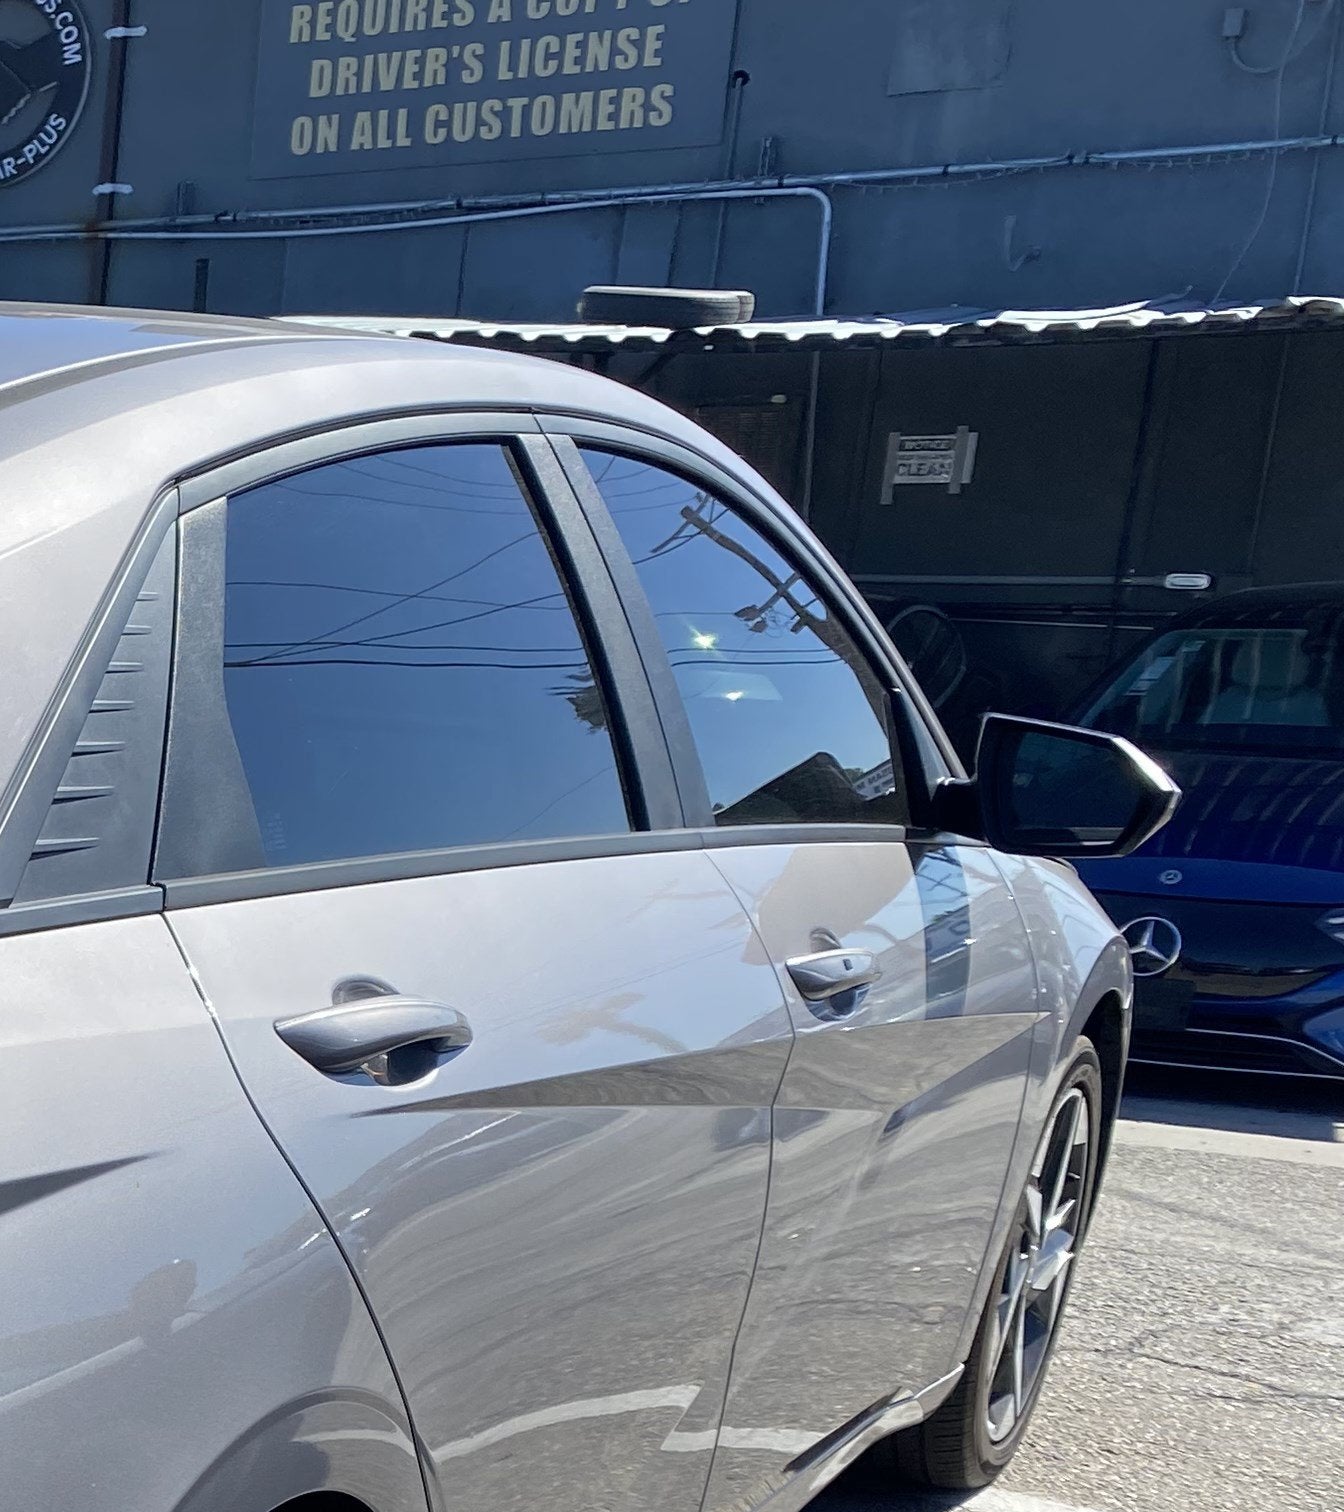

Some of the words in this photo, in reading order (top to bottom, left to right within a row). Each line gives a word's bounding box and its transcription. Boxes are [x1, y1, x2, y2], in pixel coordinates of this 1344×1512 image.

[289, 0, 476, 43] REQUIRES
[309, 43, 485, 98] DRIVER'S
[497, 25, 666, 81] LICENSE
[290, 114, 341, 155] ON
[350, 108, 412, 151] ALL
[425, 84, 675, 144] CUSTOMERS
